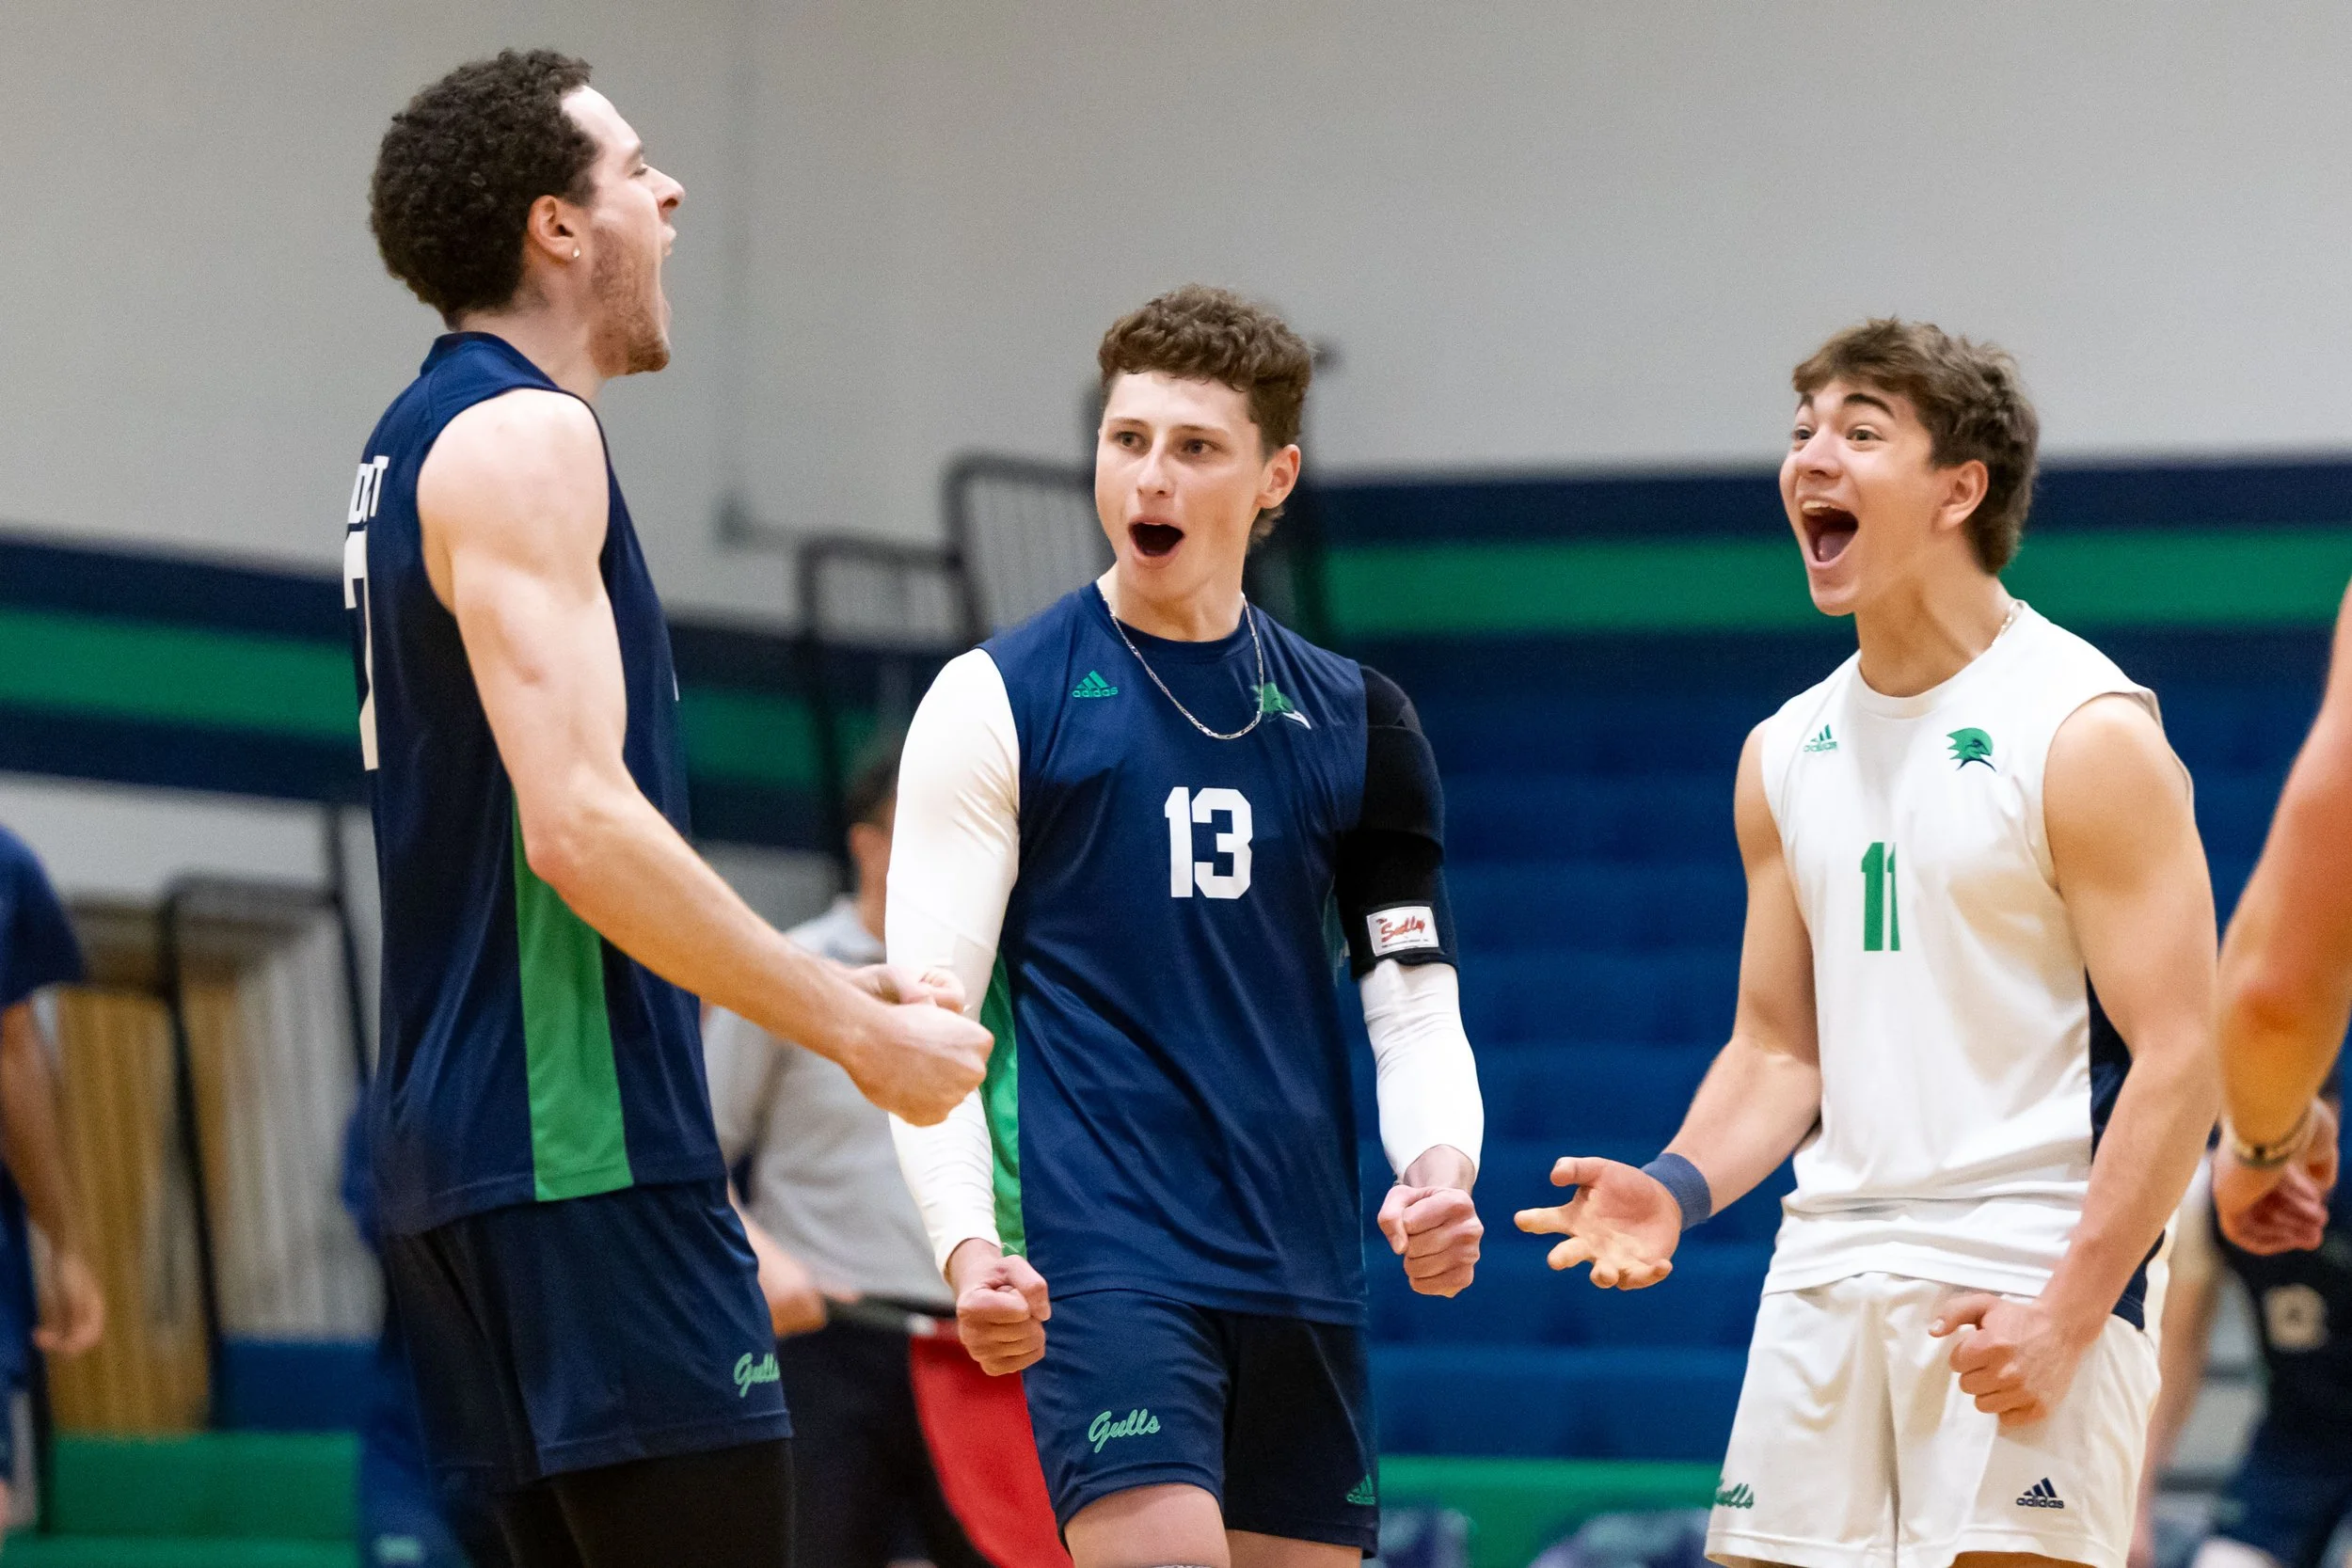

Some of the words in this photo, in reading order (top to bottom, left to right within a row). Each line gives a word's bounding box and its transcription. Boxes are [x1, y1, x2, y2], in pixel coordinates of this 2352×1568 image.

[1072, 686, 1119, 698] adidas
[1165, 786, 1253, 899] 13
[1088, 1408, 1162, 1454] Gulls
[1715, 1479, 1755, 1510] ulls
[2015, 1496, 2065, 1510] adidas
